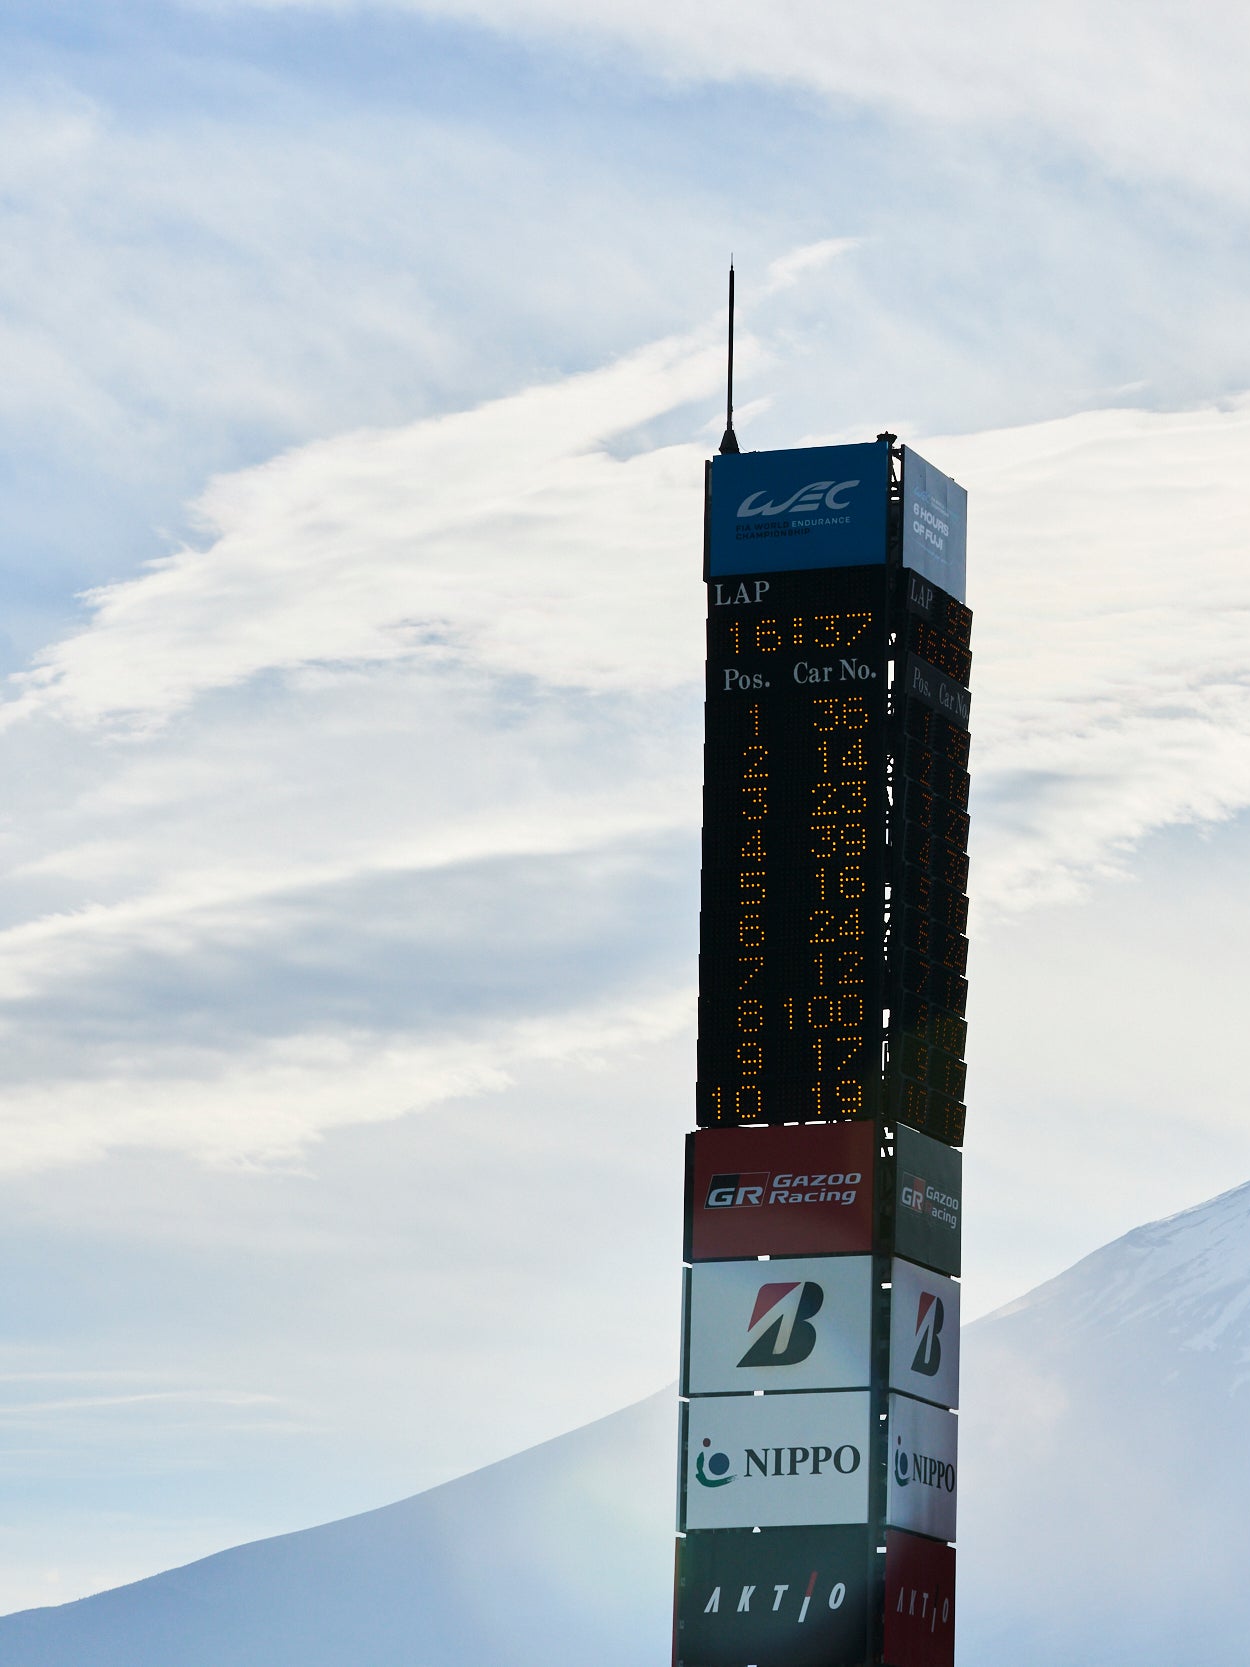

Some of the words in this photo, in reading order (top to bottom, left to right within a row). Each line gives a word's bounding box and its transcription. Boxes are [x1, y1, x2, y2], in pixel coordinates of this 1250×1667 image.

[736, 479, 861, 518] WEC
[736, 523, 752, 533] FIA
[754, 520, 791, 531] WORLD
[791, 516, 851, 528] ENDURANCE
[736, 527, 811, 541] CHAMPIONSHIP
[913, 503, 920, 516] 6
[920, 507, 949, 537] HOURS
[913, 521, 925, 536] OF
[925, 529, 943, 551] FUJI
[714, 580, 771, 606] LAP
[910, 578, 933, 610] LAP
[729, 612, 873, 655] 16:37
[723, 668, 772, 691] Pos.
[793, 661, 833, 684] Car
[839, 658, 877, 682] No.
[912, 666, 931, 697] Pos.
[939, 682, 956, 706] Car
[749, 704, 759, 736] 1
[813, 697, 869, 732] 36
[743, 745, 769, 778] 2
[818, 738, 868, 773] 14
[742, 787, 768, 820] 3
[811, 780, 867, 816] 23
[741, 829, 767, 862] 4
[810, 823, 866, 858] 39
[740, 872, 766, 905] 5
[815, 866, 865, 900] 16
[739, 914, 765, 947] 6
[809, 908, 865, 943] 24
[738, 956, 764, 990] 7
[813, 951, 864, 986] 12
[916, 961, 931, 993] 7
[738, 999, 763, 1033] 8
[783, 993, 863, 1030] 100
[737, 1042, 762, 1075] 9
[812, 1036, 862, 1071] 17
[711, 1085, 761, 1120] 10
[811, 1080, 862, 1115] 19
[707, 1186, 765, 1207] GR
[768, 1188, 857, 1205] Racing
[772, 1172, 862, 1188] GAZOO
[901, 1187, 923, 1212] GR
[925, 1185, 959, 1212] GAZOO
[743, 1444, 861, 1478] NIPPO
[912, 1452, 956, 1493] NIPPO
[703, 1571, 847, 1623] AKTIO
[896, 1583, 950, 1633] AKTIO
